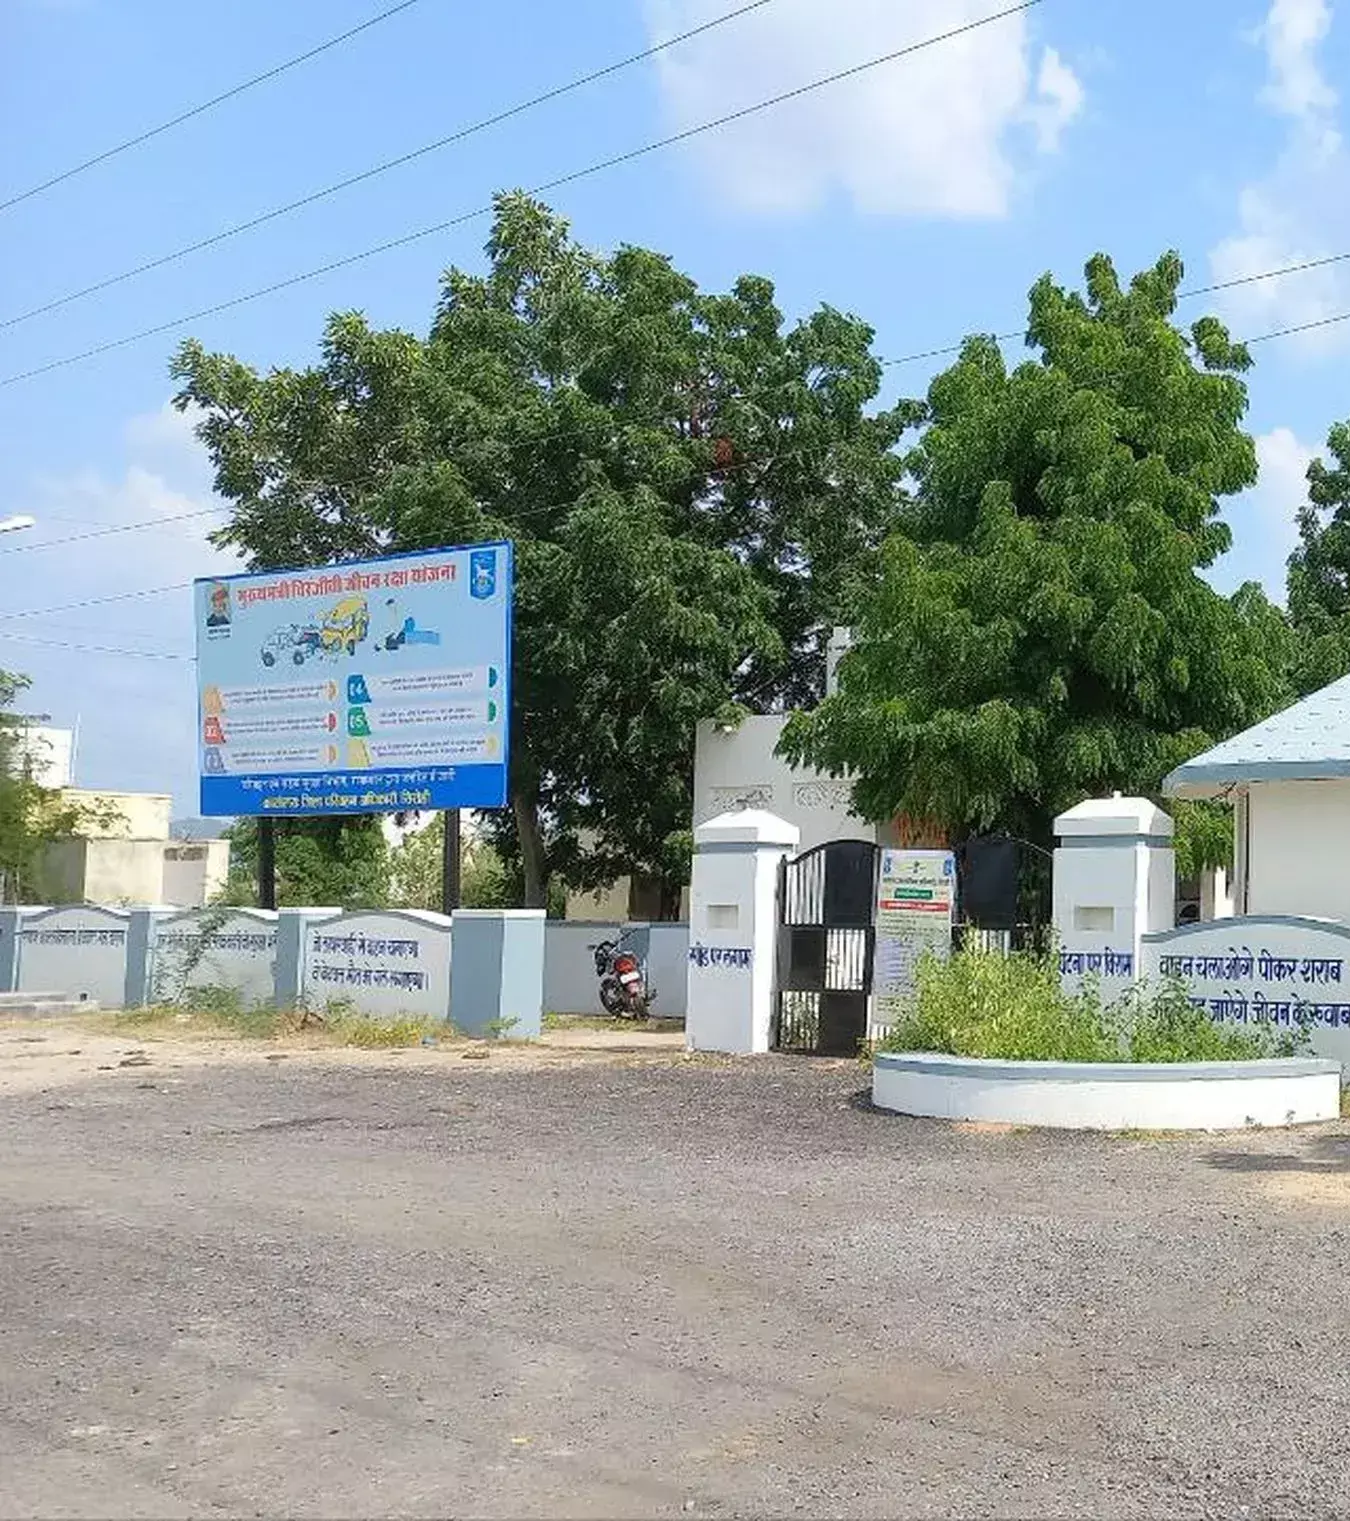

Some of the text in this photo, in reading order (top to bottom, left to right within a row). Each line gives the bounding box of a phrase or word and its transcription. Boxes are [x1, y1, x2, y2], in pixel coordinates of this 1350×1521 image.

[1159, 947, 1344, 987] वाहन चलाओगे पीकर शराब
